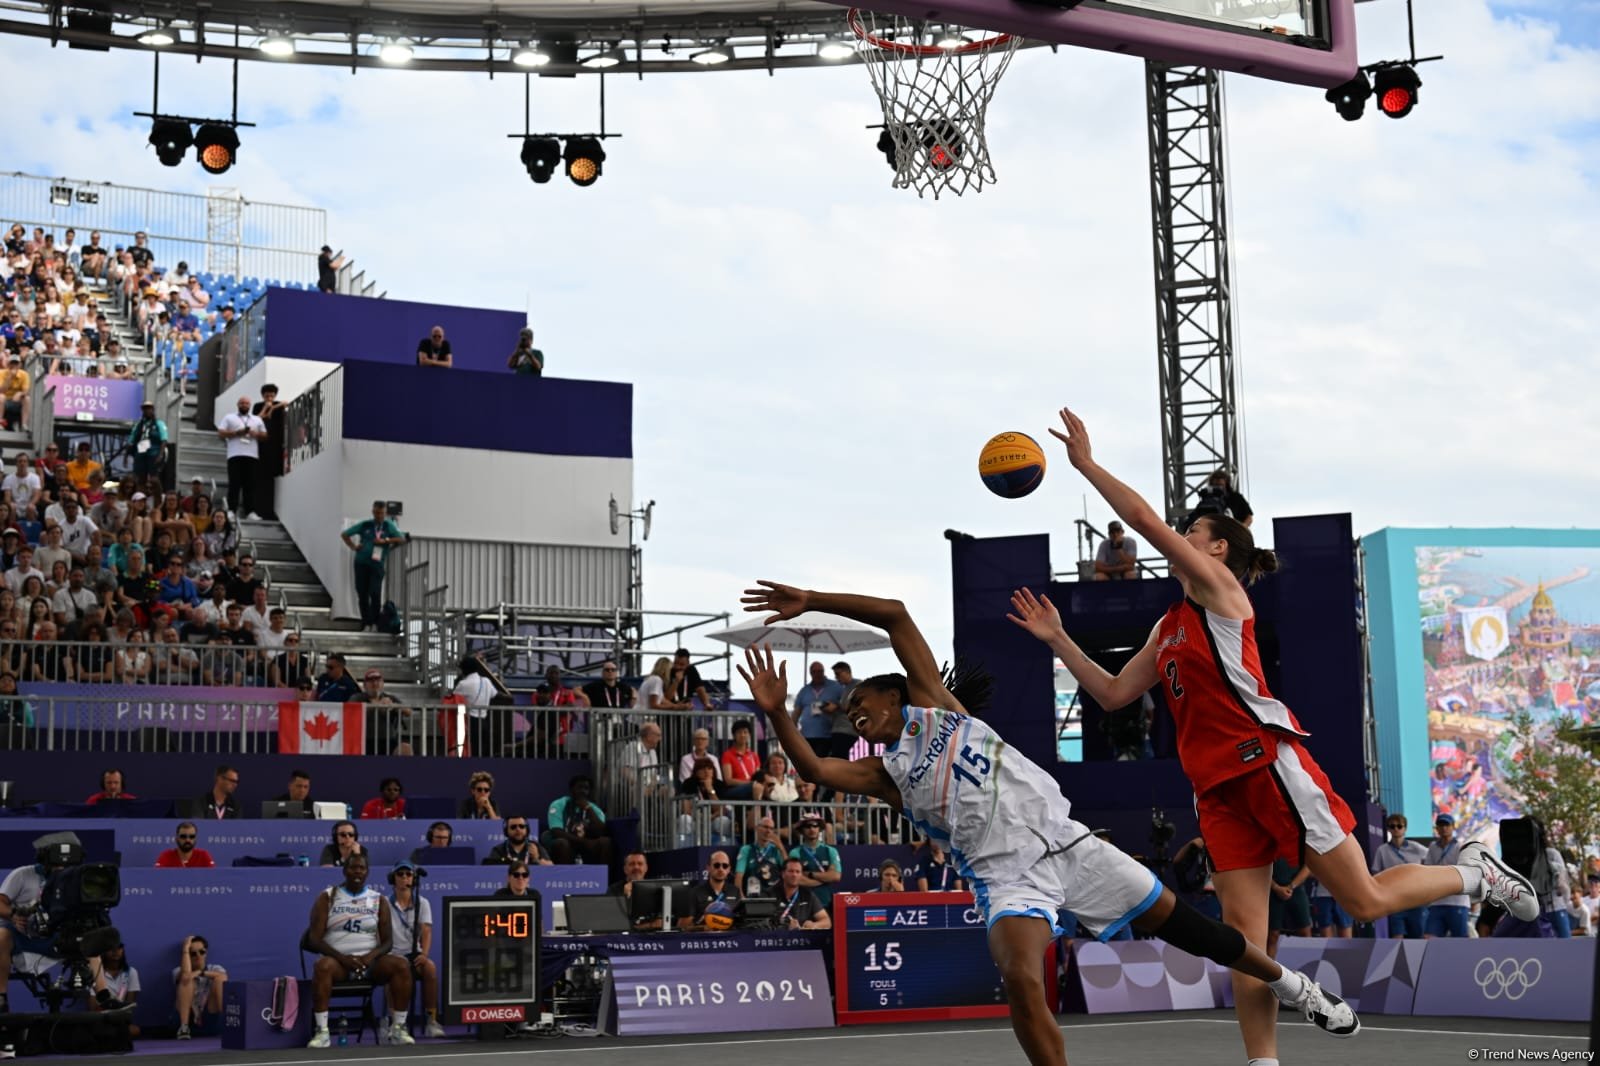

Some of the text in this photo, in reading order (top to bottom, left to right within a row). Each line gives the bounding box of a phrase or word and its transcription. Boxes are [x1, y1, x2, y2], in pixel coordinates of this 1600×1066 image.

[63, 384, 109, 398] PARIS
[63, 397, 109, 411] 2024
[1164, 658, 1184, 699] 2
[116, 701, 206, 720] PARIS
[951, 745, 991, 788] 15
[208, 836, 265, 844] PARIS 2024
[855, 868, 880, 878] PAR
[124, 887, 153, 895] 2024
[170, 886, 232, 894] PARIS 2024
[250, 885, 280, 893] PARIS
[474, 881, 502, 889] PARIS
[545, 880, 600, 889] PARIS 2024
[892, 910, 928, 926] AZE
[343, 920, 361, 933] 45
[485, 913, 528, 938] 1:40
[680, 940, 739, 949] PARIS 2024
[864, 942, 903, 971] 15
[870, 979, 897, 988] FOULS
[736, 979, 814, 1003] 2024
[879, 993, 889, 1006] 5
[479, 1008, 522, 1020] OMEGA
